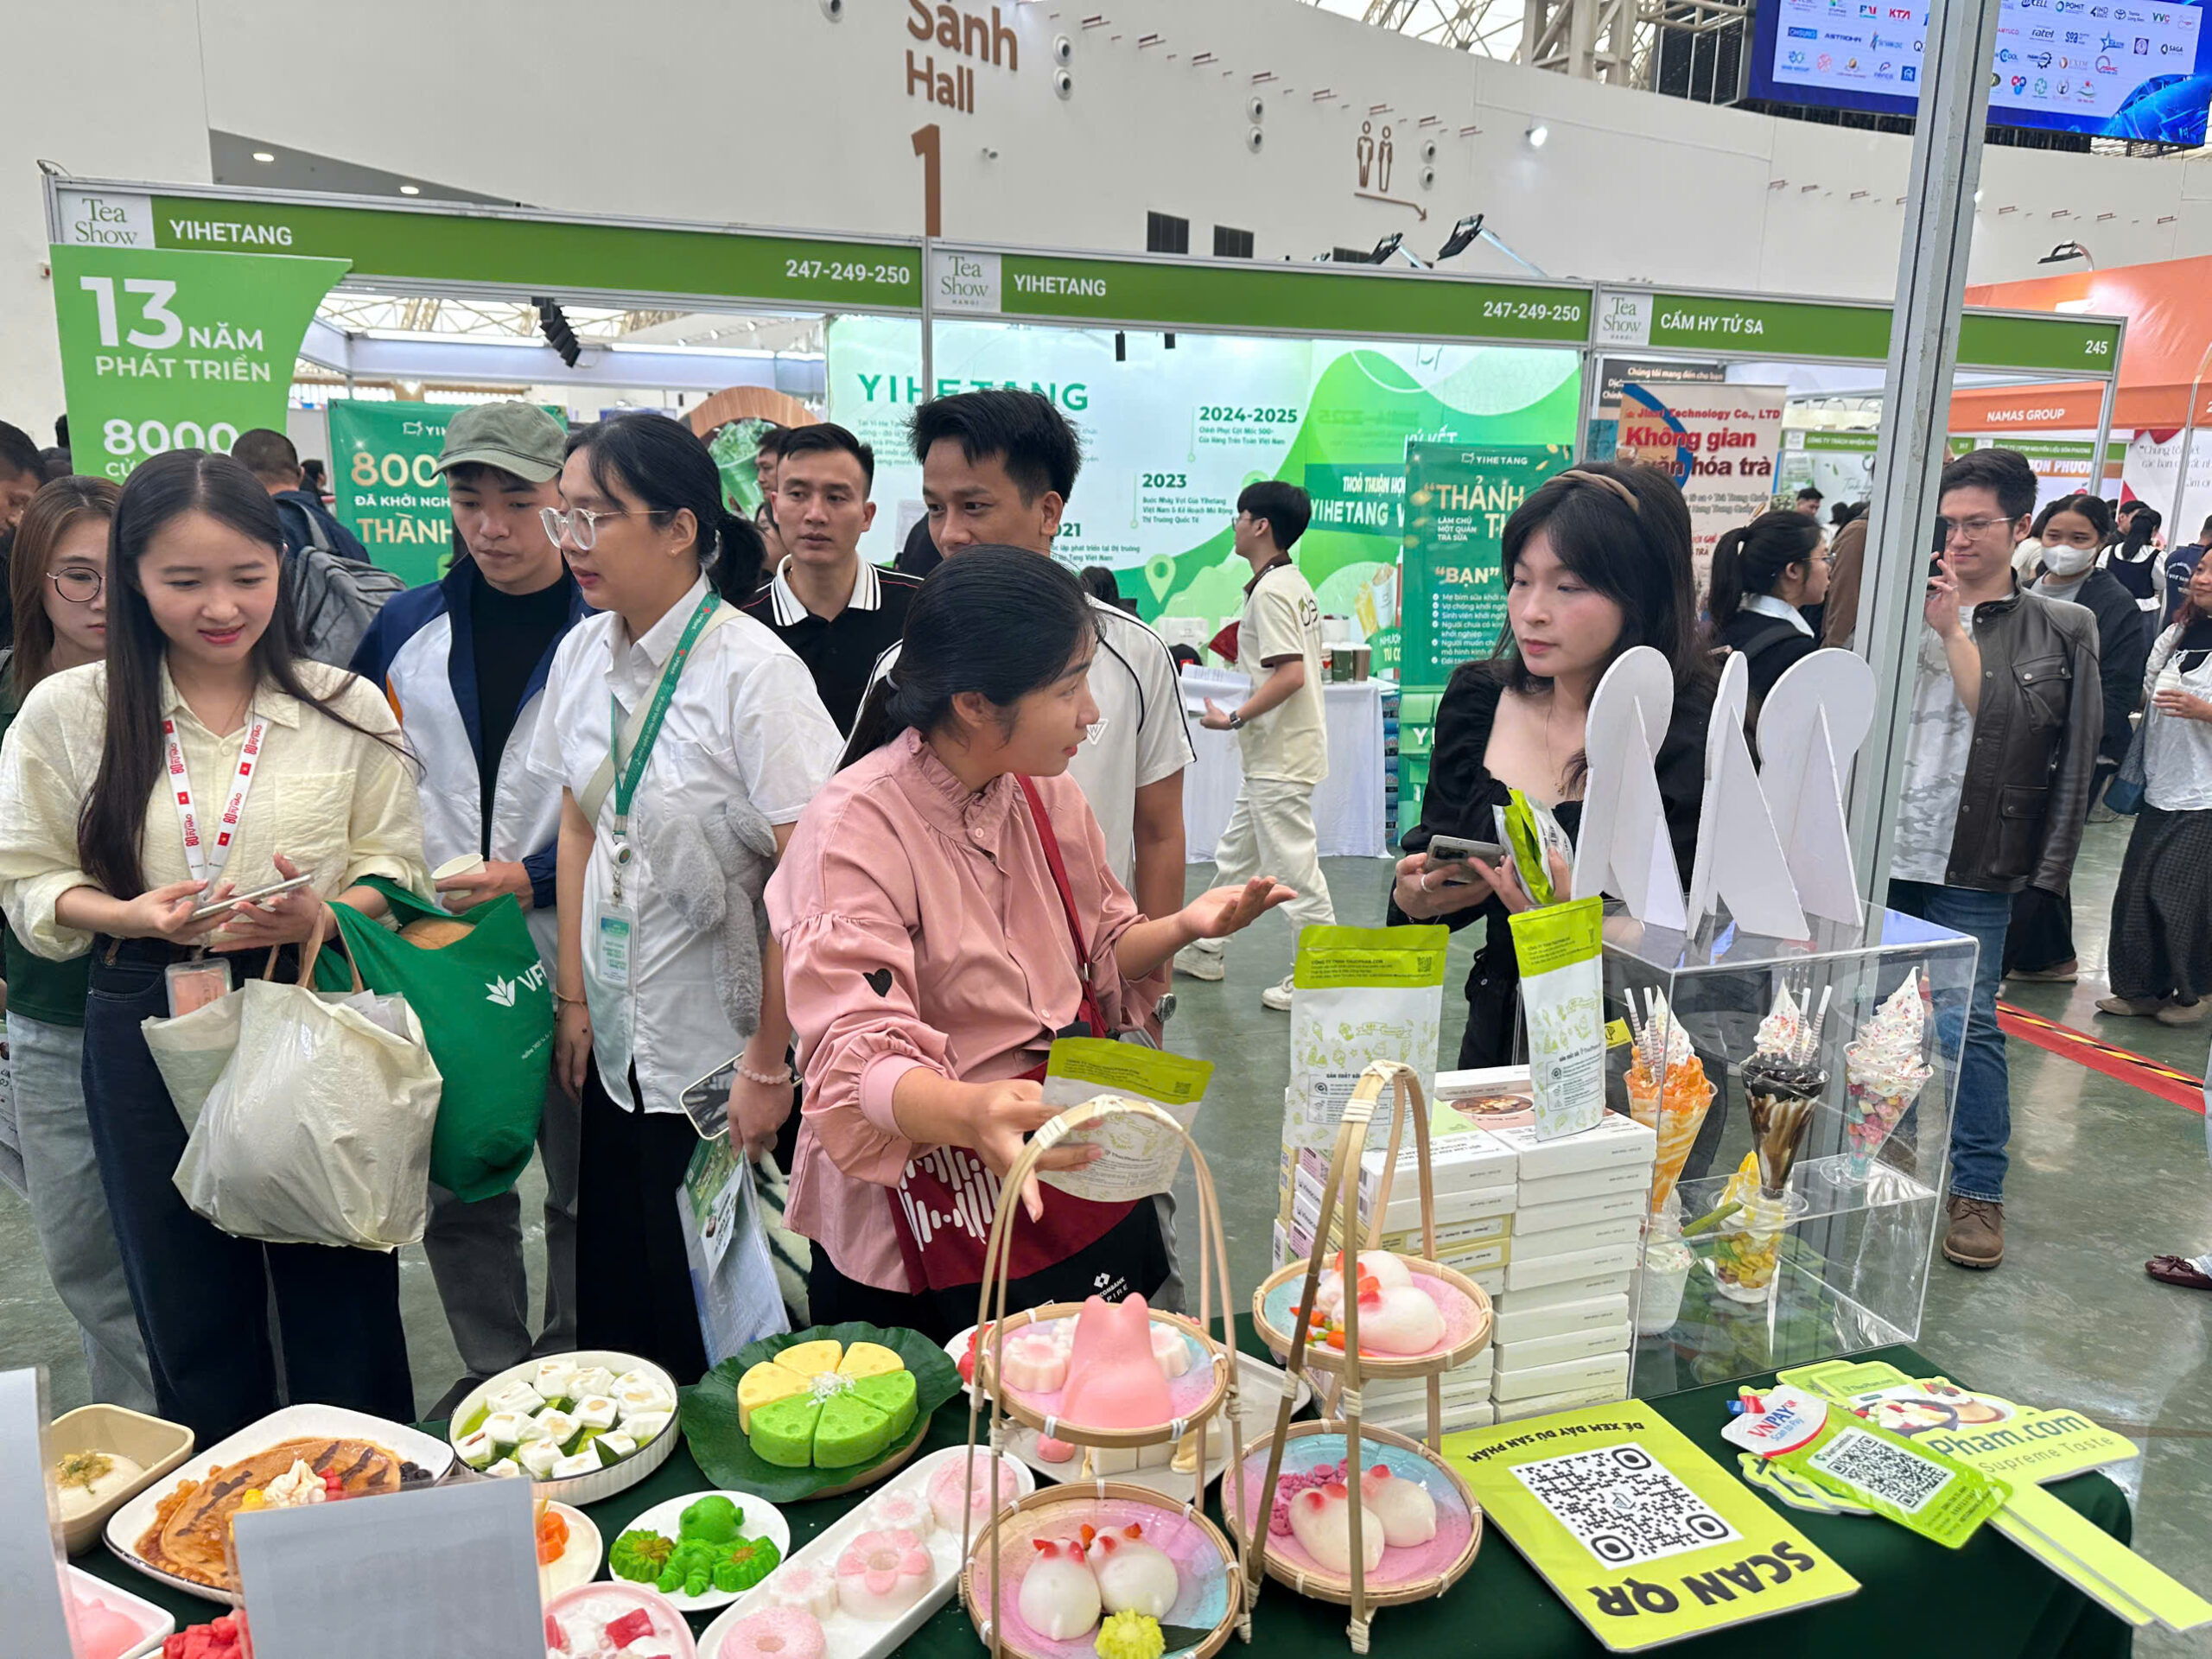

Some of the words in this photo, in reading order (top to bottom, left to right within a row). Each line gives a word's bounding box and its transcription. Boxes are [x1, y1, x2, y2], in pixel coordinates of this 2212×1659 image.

[906, 49, 974, 114] Hall
[911, 123, 941, 237] 1
[82, 197, 126, 223] Tea
[75, 221, 137, 245] Show
[169, 219, 293, 246] YIHETANG
[786, 259, 911, 285] 247-249-250
[948, 256, 982, 277] Tea
[941, 276, 988, 297] Show
[1014, 274, 1107, 296] YIHETANG
[80, 276, 183, 349] 13
[188, 322, 264, 351] NĂM
[1483, 301, 1581, 322] 247-249-250
[1611, 297, 1637, 316] Tea
[1603, 315, 1641, 333] Show
[1698, 316, 1718, 331] HY
[1744, 319, 1764, 334] SA
[2085, 340, 2108, 355] 245
[96, 355, 176, 379] PHÁT
[184, 353, 271, 382] TRIỂN
[1199, 406, 1297, 423] 2024-2025
[1669, 409, 1730, 421] Technology
[1758, 409, 1780, 420] LTD
[1987, 409, 2024, 423] NAMAS
[2027, 407, 2066, 421] GROUP
[1625, 426, 1702, 453] Không
[1707, 428, 1757, 453] gian
[1476, 456, 1528, 465] YIHETANG
[1691, 455, 1732, 476] hóa
[1738, 456, 1771, 477] trà
[1142, 474, 1186, 488] 2023
[354, 493, 377, 507] ĐÃ
[380, 493, 416, 507] KHỞI
[1310, 498, 1389, 525] YIHETANG
[1589, 1422, 1622, 1433] XEM
[1747, 1404, 1796, 1438] VNPAY
[1978, 1446, 2062, 1474] Supreme
[2062, 1434, 2114, 1455] Taste
[1680, 1540, 1815, 1606] SCAN
[1586, 1577, 1680, 1617] QR
